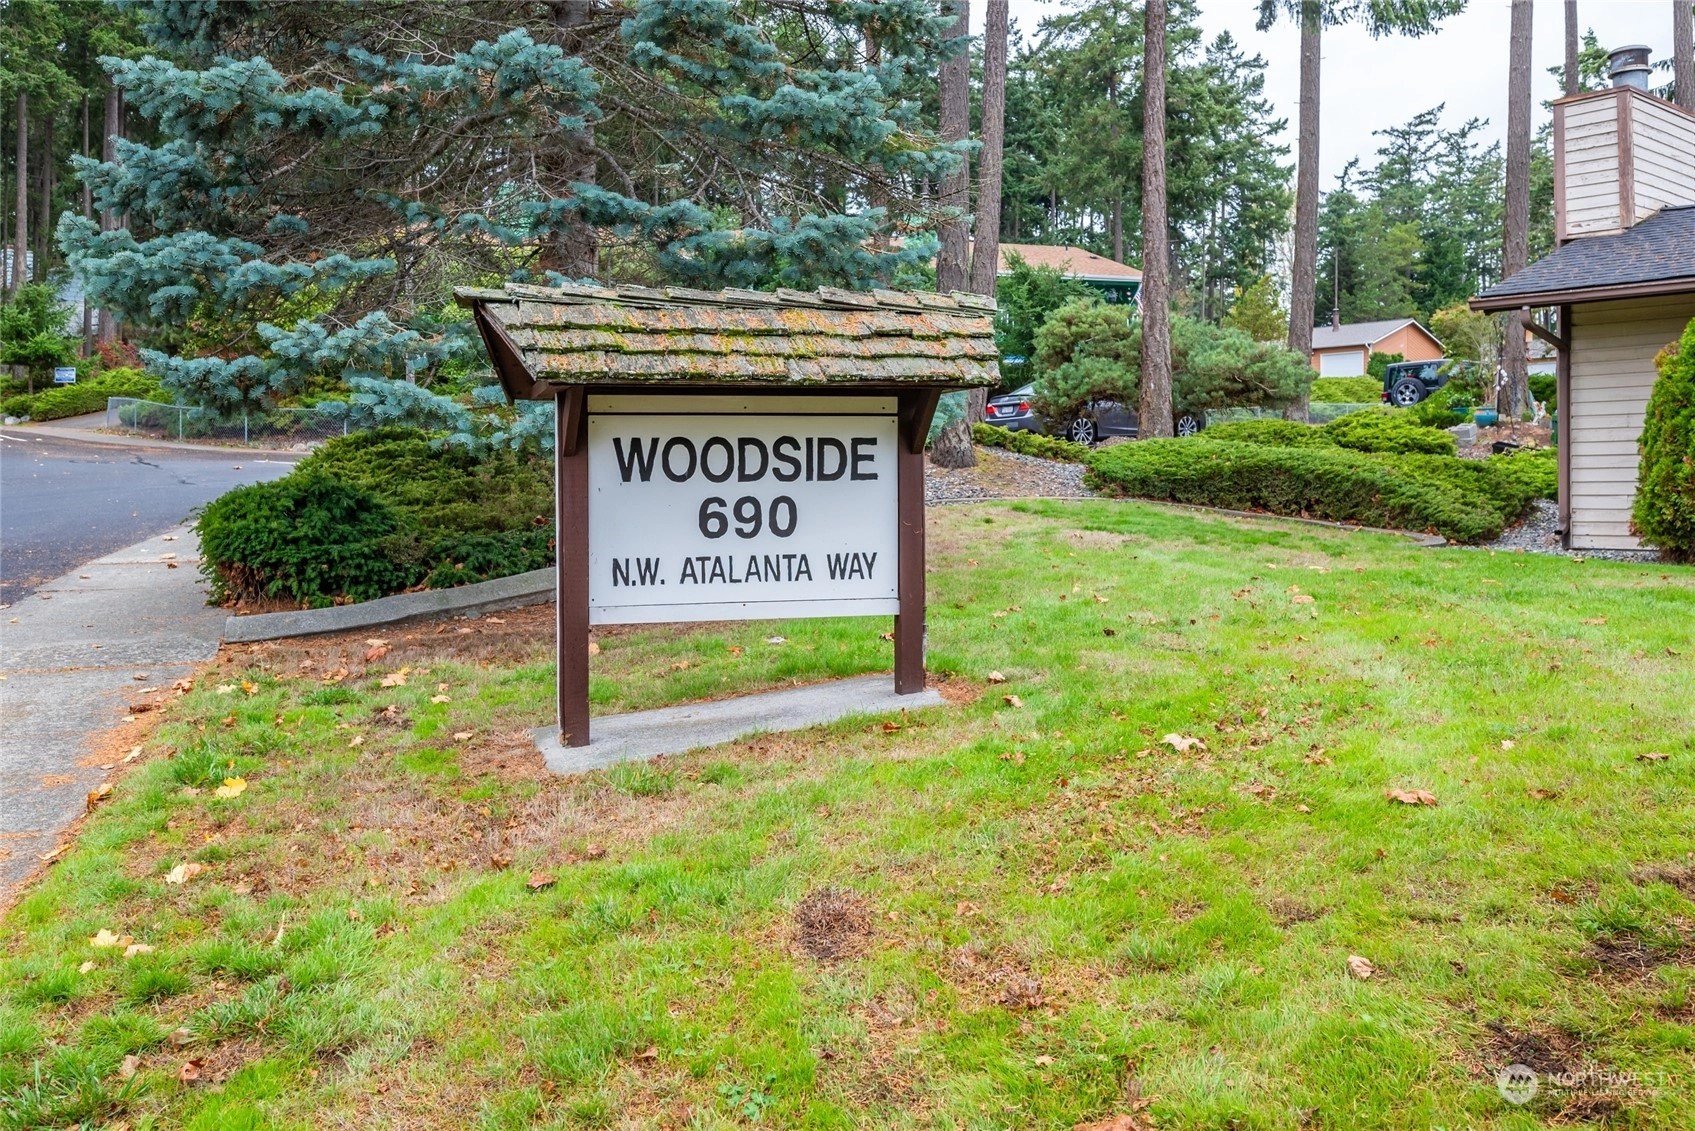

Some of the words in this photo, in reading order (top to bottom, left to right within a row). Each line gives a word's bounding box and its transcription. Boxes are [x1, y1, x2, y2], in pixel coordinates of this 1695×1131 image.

[612, 435, 879, 483] WOODSIDE
[698, 495, 798, 539] 690
[612, 557, 665, 587] N.W.
[679, 553, 813, 585] ATALANTA
[826, 552, 878, 580] WAY
